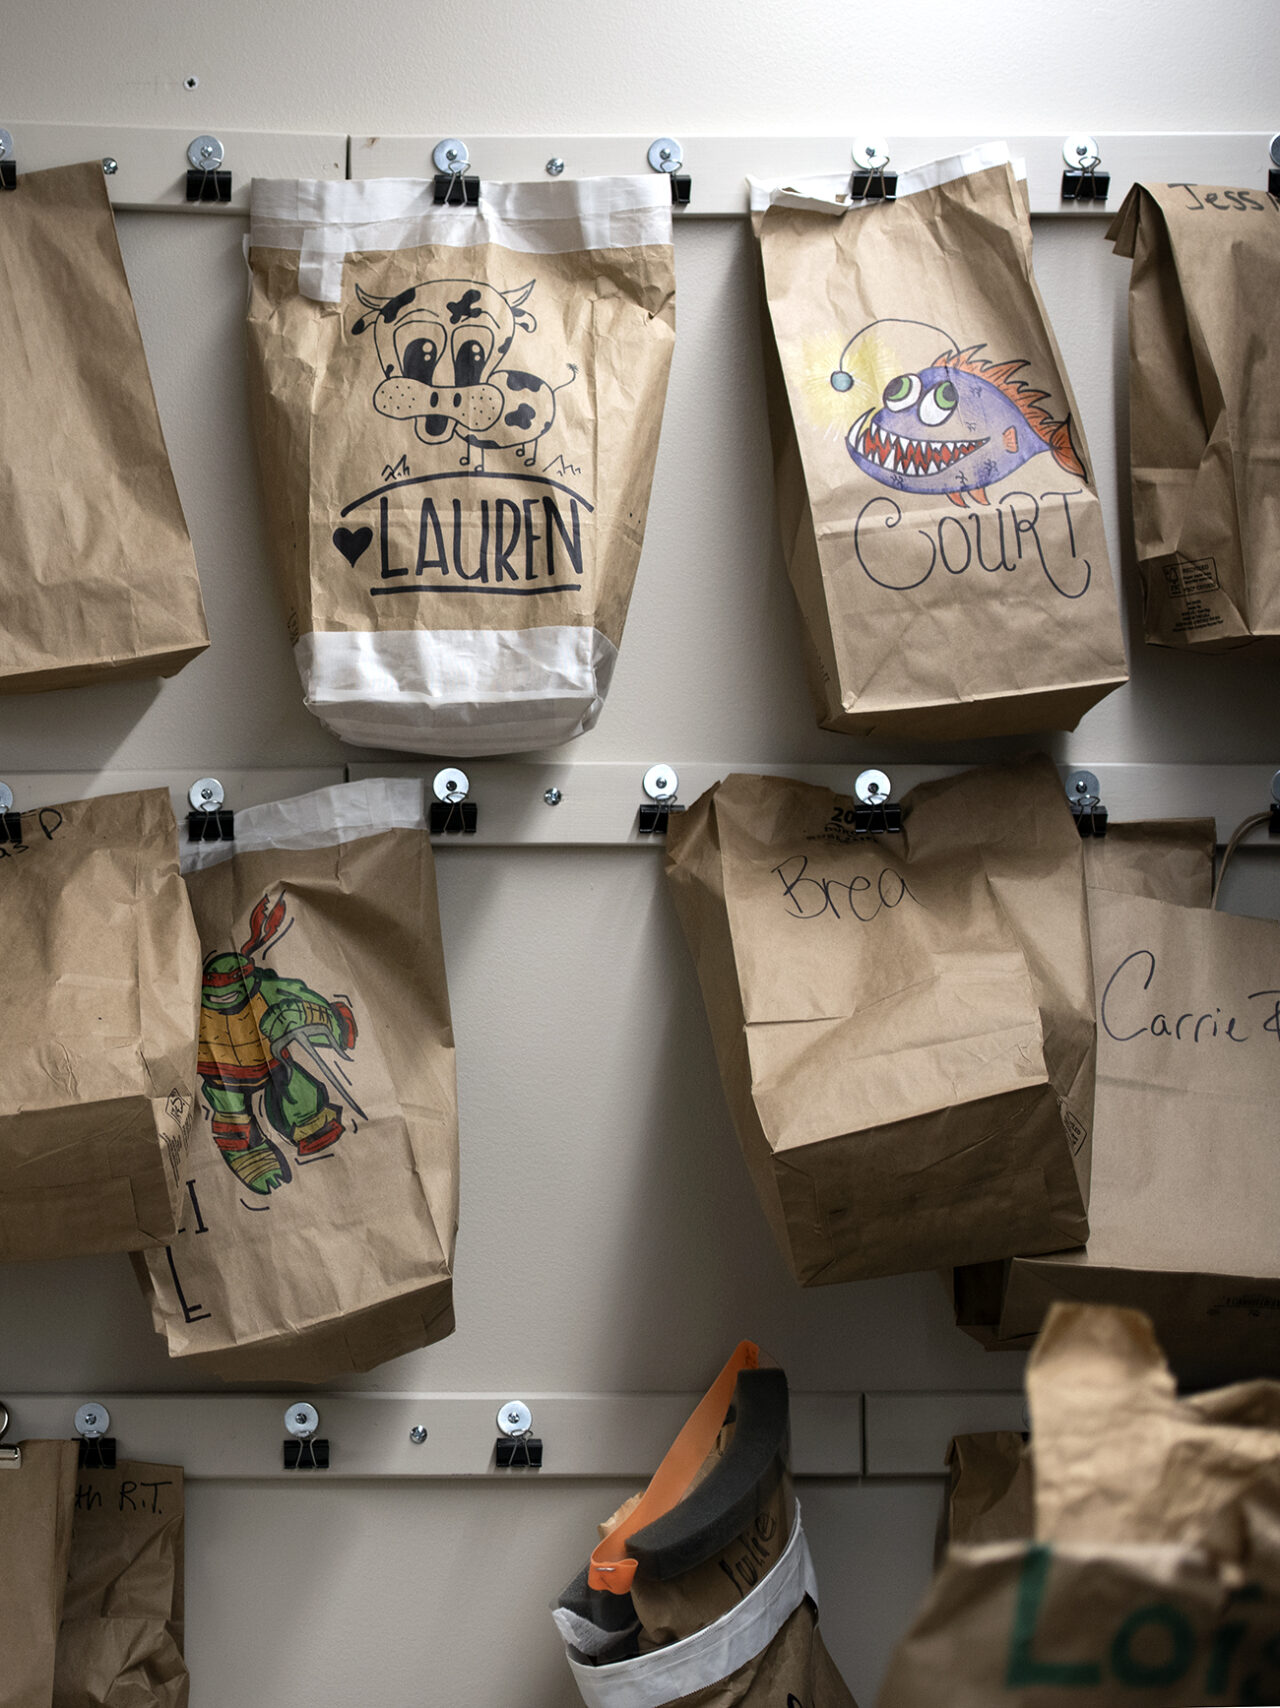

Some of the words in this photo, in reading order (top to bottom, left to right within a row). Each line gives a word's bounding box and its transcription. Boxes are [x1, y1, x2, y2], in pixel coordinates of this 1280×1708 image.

[1167, 183, 1265, 212] Jess
[379, 496, 584, 585] LAUREN
[39, 808, 63, 841] P
[771, 855, 929, 921] Brea
[1101, 950, 1249, 1042] Carrie
[119, 1481, 172, 1514] R.T.
